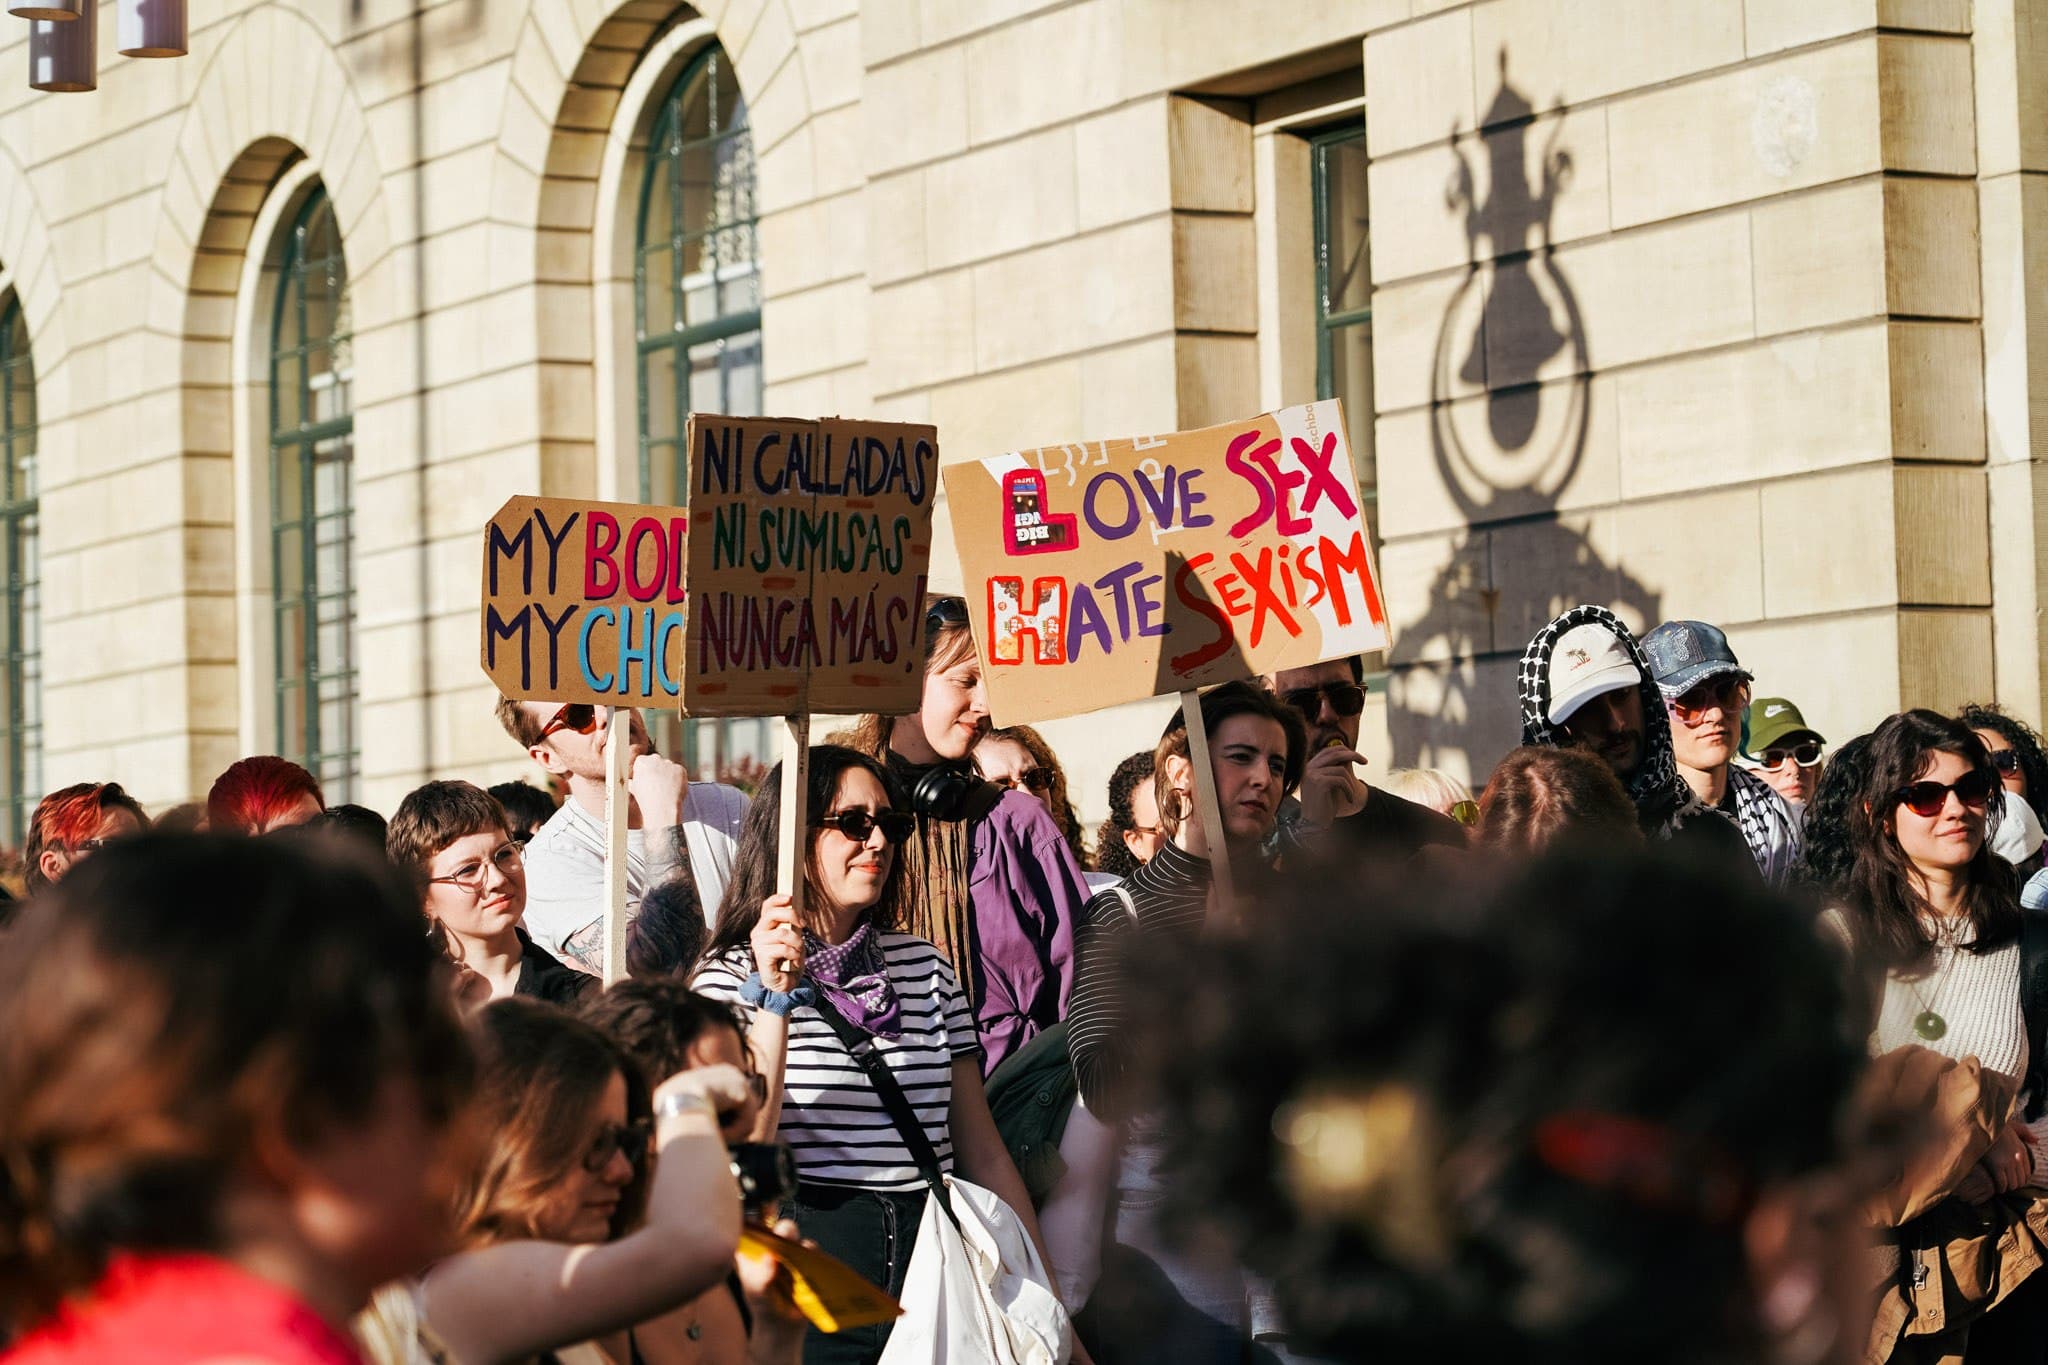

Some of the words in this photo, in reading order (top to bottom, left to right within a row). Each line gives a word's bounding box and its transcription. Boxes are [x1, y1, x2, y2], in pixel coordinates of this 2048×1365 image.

[702, 427, 743, 495] NI
[753, 430, 933, 507] CALLADAS
[1003, 464, 1215, 557] LOVE
[1226, 430, 1358, 539] SEX
[488, 508, 580, 597] MY
[713, 502, 745, 570] NI
[751, 508, 911, 575] SUMISAS
[487, 603, 579, 691] MY
[699, 590, 822, 674] NUNCA
[829, 574, 927, 674] MÁS!
[986, 561, 1172, 666] HATE
